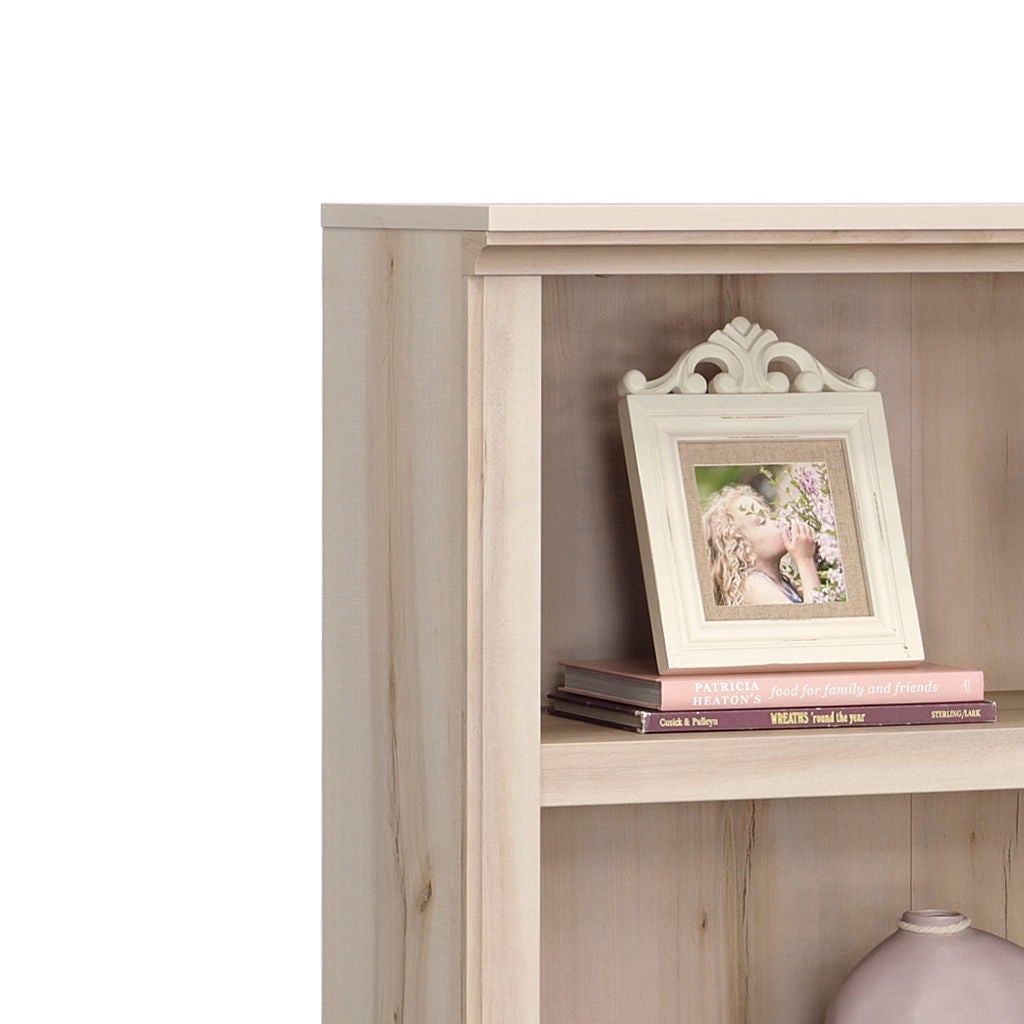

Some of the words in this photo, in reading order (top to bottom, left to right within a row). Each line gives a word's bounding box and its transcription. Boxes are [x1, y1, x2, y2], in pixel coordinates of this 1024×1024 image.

[694, 681, 760, 692] PATRICIA
[769, 683, 798, 699] food
[800, 683, 820, 699] for
[822, 682, 864, 698] family
[868, 681, 891, 695] and
[893, 680, 938, 697] friends
[692, 694, 762, 706] HEATON'S
[770, 711, 809, 724] WREATHS
[835, 711, 848, 723] the
[849, 713, 866, 725] year
[931, 708, 982, 719] STERLING/LARK
[659, 718, 683, 727] Cusick
[684, 718, 690, 726] &
[692, 717, 718, 728] Pulleyn
